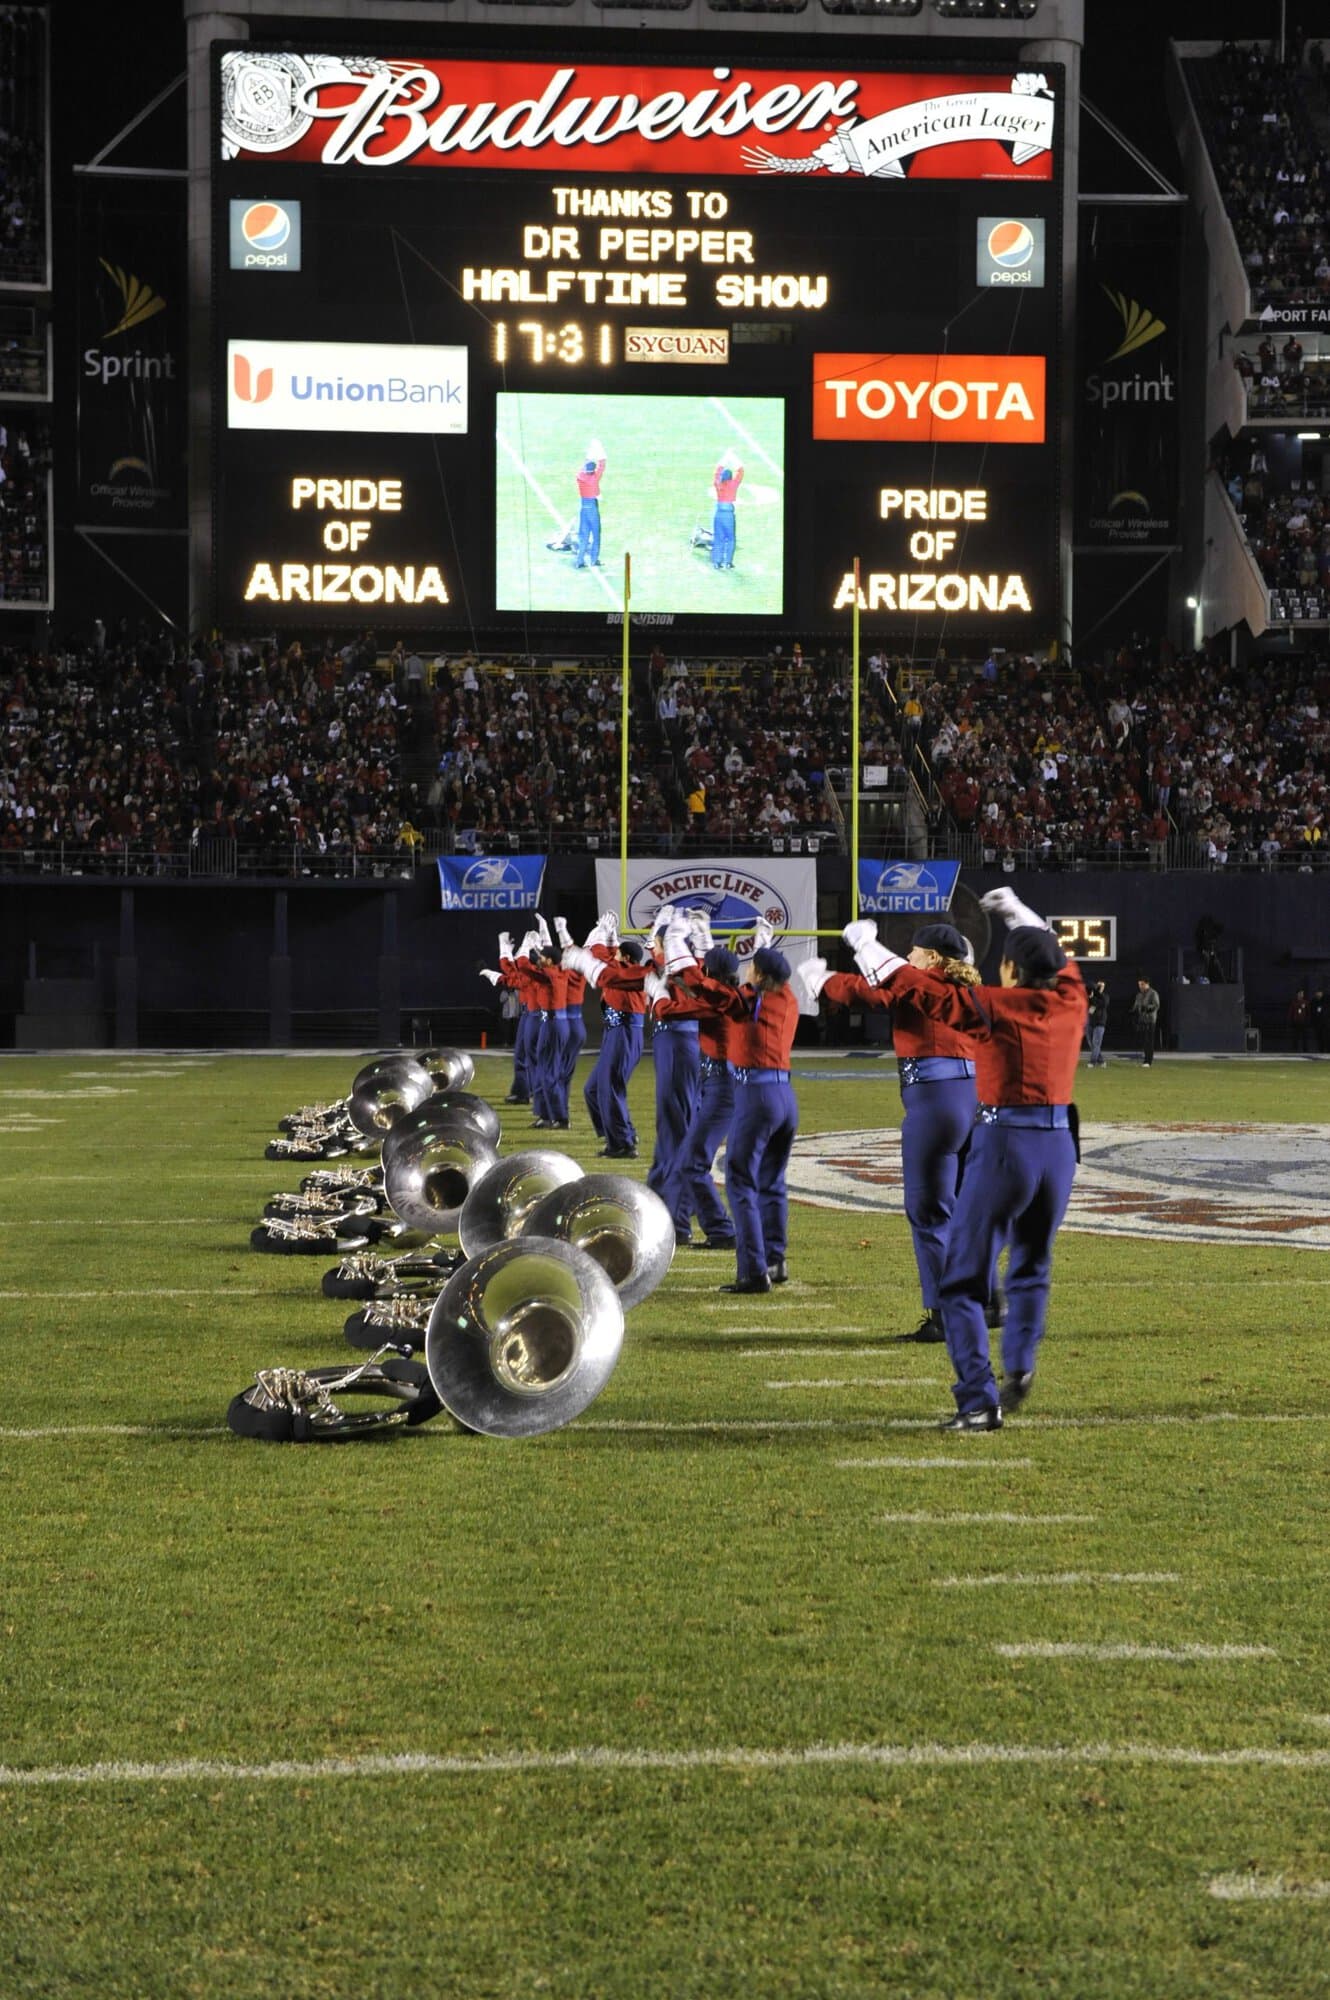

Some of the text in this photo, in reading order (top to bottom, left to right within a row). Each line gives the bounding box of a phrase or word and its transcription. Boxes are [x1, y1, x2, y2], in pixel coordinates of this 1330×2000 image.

[303, 67, 859, 165] Budweiser
[867, 107, 1046, 159] American Lager
[553, 188, 728, 219] THANKS TO
[245, 253, 288, 268] pepsi
[524, 226, 755, 264] DR PEPPER
[463, 269, 828, 309] HALFTIME SHOW
[990, 269, 1031, 285] pepsi
[628, 336, 726, 355] SYCUAN
[84, 348, 175, 385] Sprint
[825, 380, 1035, 421] TOYOTA
[1086, 373, 1174, 409] Sprint
[292, 478, 402, 511] PRIDE
[880, 489, 987, 521] PRIDE
[323, 521, 372, 552] OF
[909, 531, 957, 561] OF
[245, 564, 450, 604] ARIZONA
[832, 573, 1032, 612] ARIZONA
[637, 613, 675, 626] VISION
[442, 890, 536, 910] PACIFIC LIF
[650, 873, 765, 902] PACIFIC LIFE
[859, 893, 921, 912] PACIFIC
[1057, 919, 1105, 958] 25
